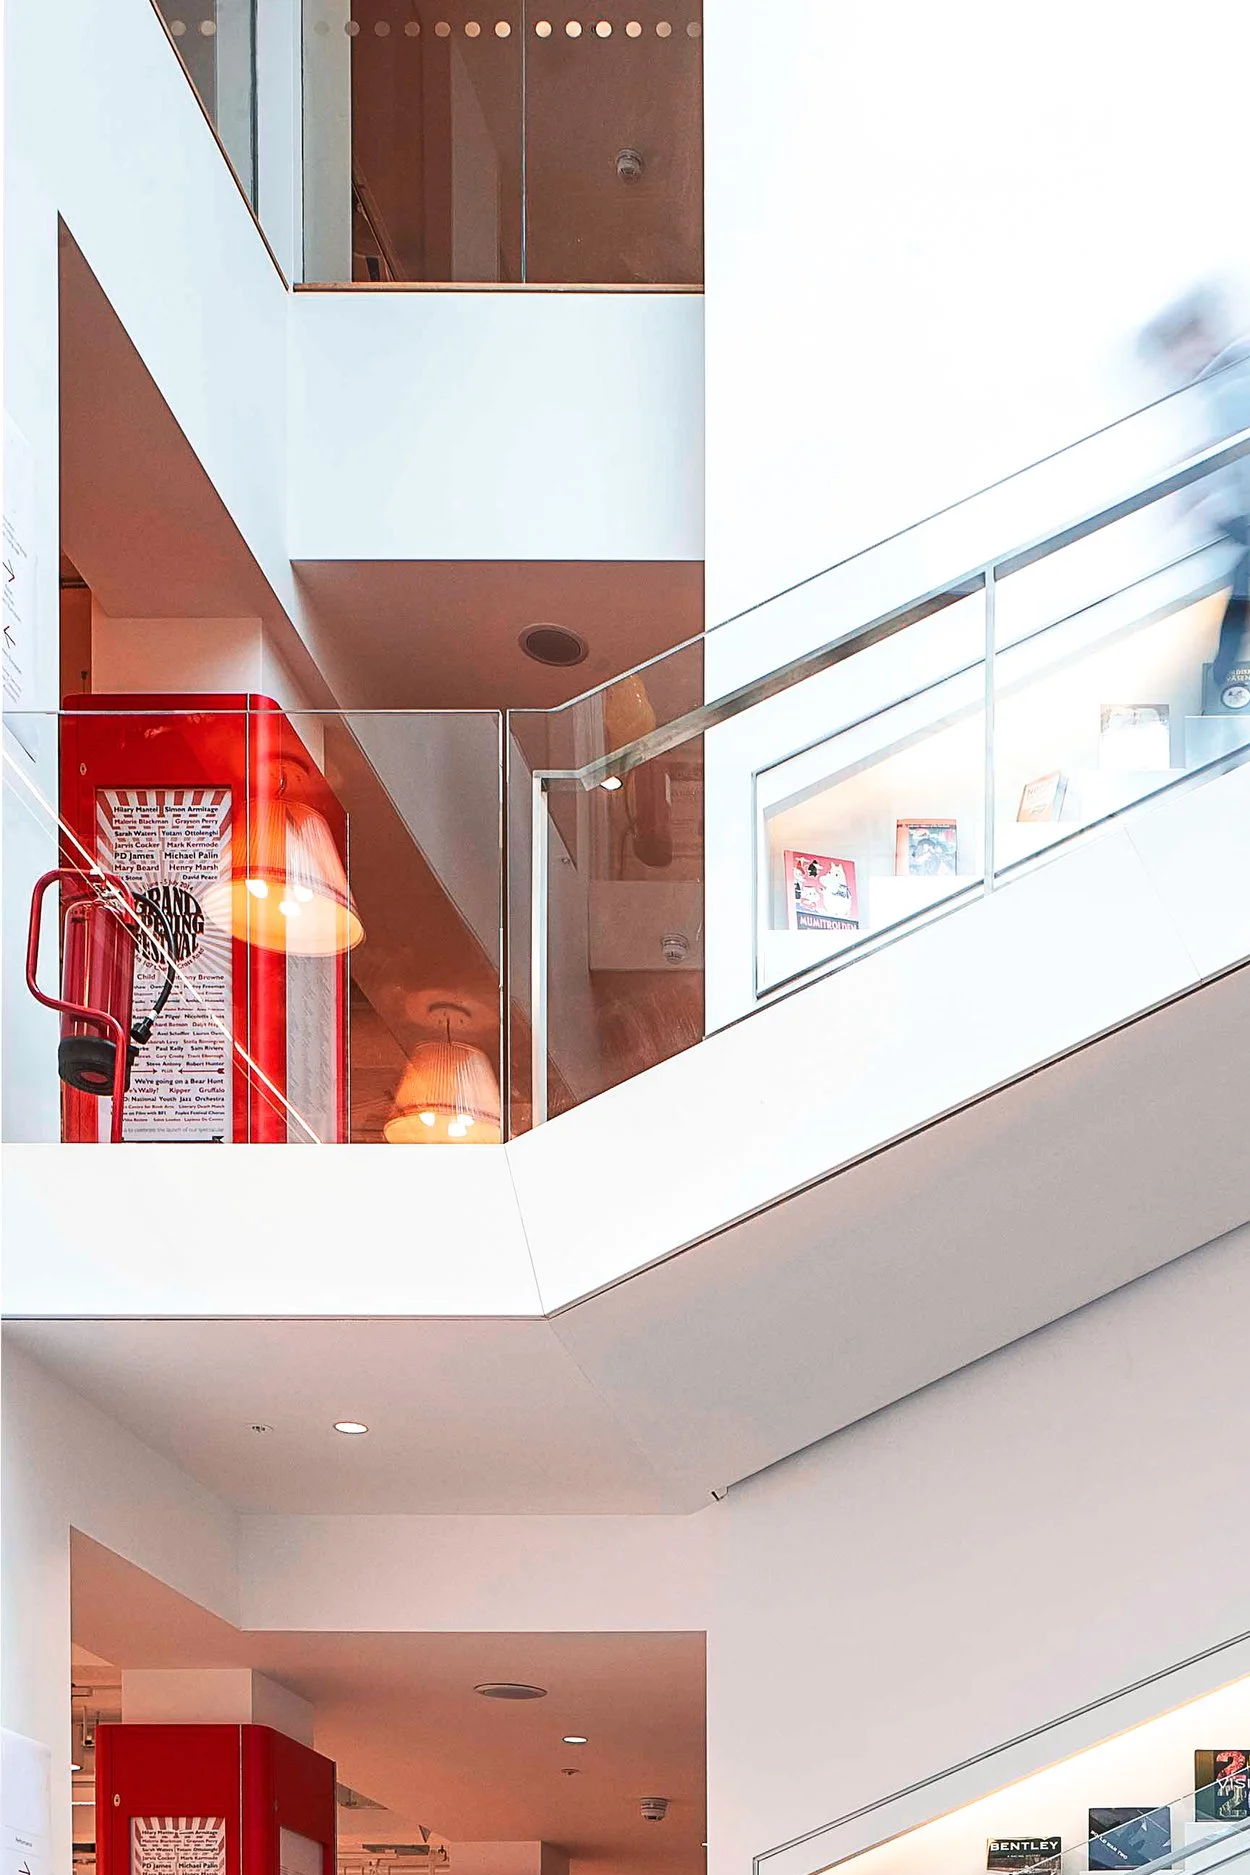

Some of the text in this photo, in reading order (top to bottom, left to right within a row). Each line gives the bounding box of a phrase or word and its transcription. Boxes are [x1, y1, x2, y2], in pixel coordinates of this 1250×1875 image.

[129, 852, 154, 860] James
[114, 864, 133, 872] Mary
[169, 864, 193, 872] Henry
[169, 1087, 190, 1095] Kipper
[990, 1841, 1059, 1851] BENTLEY
[1106, 1841, 1118, 1853] WAR
[1117, 1849, 1128, 1860] TWO
